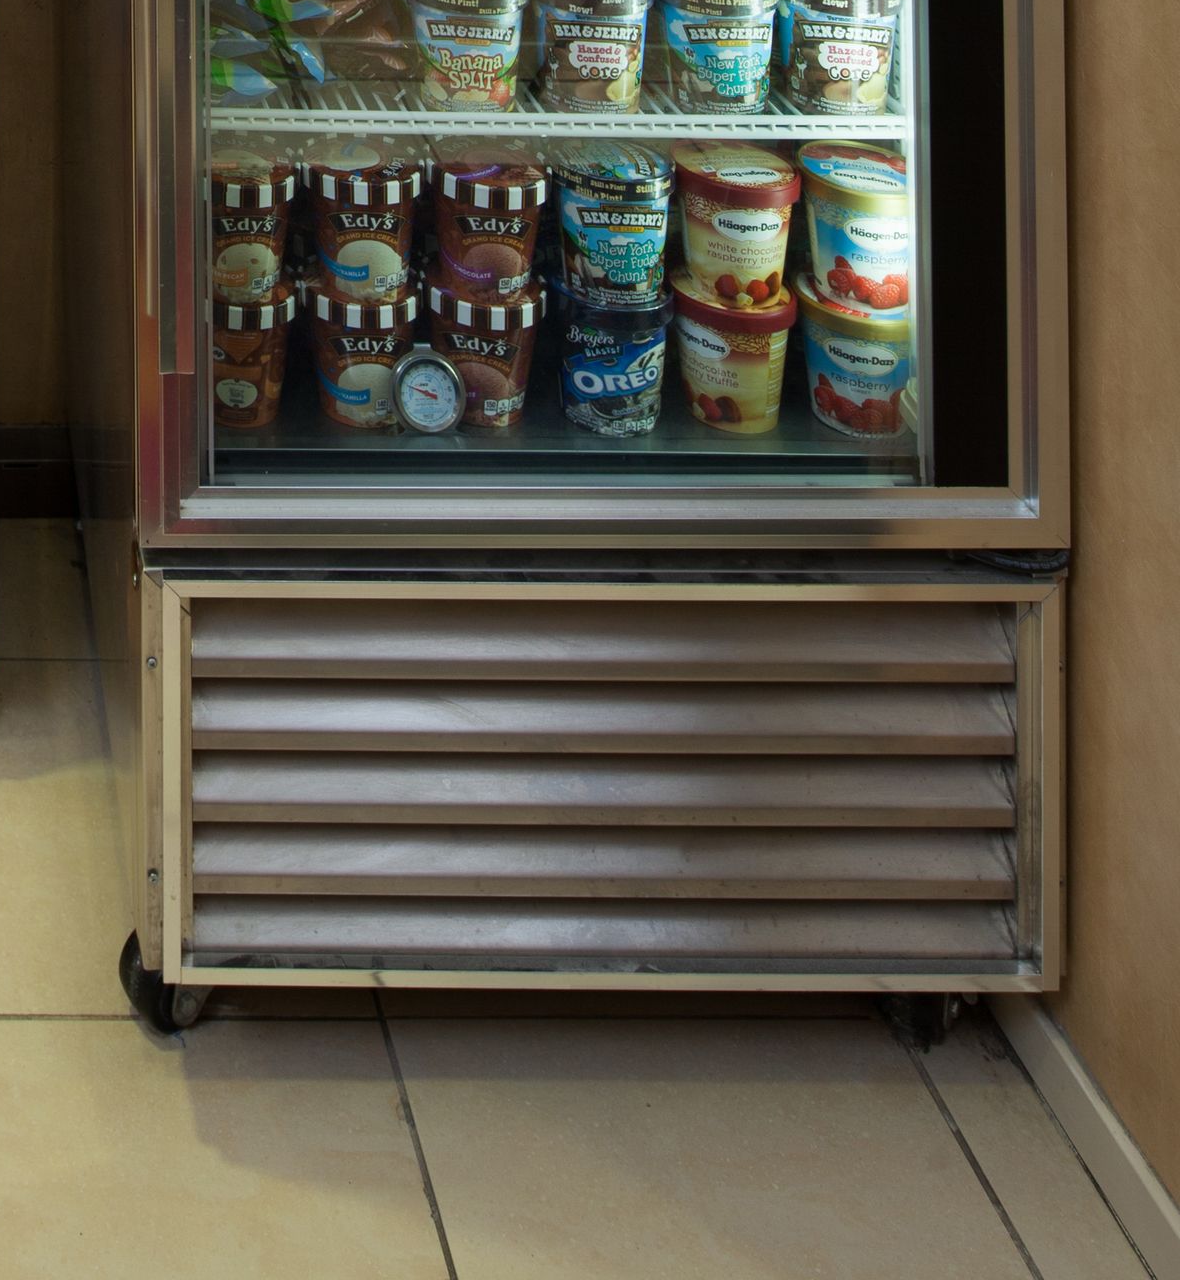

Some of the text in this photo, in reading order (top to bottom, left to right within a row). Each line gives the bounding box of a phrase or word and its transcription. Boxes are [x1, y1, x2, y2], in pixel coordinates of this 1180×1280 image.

[456, 0, 479, 8] Pint!
[568, 4, 594, 15] new!
[577, 45, 613, 54] Hazed
[828, 45, 865, 55] Hazed
[440, 49, 503, 72] Banana
[576, 53, 621, 64] Confused
[707, 53, 760, 69] New York
[579, 64, 620, 79] Core
[698, 67, 736, 82] Super
[828, 66, 871, 80] Core
[449, 70, 495, 90] SPLIT
[716, 81, 756, 96] Chunk
[221, 215, 274, 234] Edy's
[339, 212, 396, 231] Edy's
[466, 216, 522, 235] Edy's
[718, 218, 780, 234] Häagen-Dazs
[599, 240, 654, 256] New York
[708, 240, 738, 253] white
[590, 252, 659, 270] Super Fudge
[708, 250, 758, 266] raspberry
[851, 251, 908, 266] raspberry
[340, 268, 367, 277] VANILLA
[453, 263, 492, 279] CHOCOLATE
[608, 268, 648, 283] Chunk
[566, 325, 615, 347] Breyers
[341, 336, 396, 355] Edy's
[451, 332, 508, 357] Edy's
[584, 345, 620, 358] BLASTS!
[828, 344, 895, 366] Häagen-Dazs
[573, 367, 658, 395] OREO
[707, 374, 740, 389] truffle
[830, 371, 892, 392] raspberry
[341, 392, 368, 401] VANILLA
